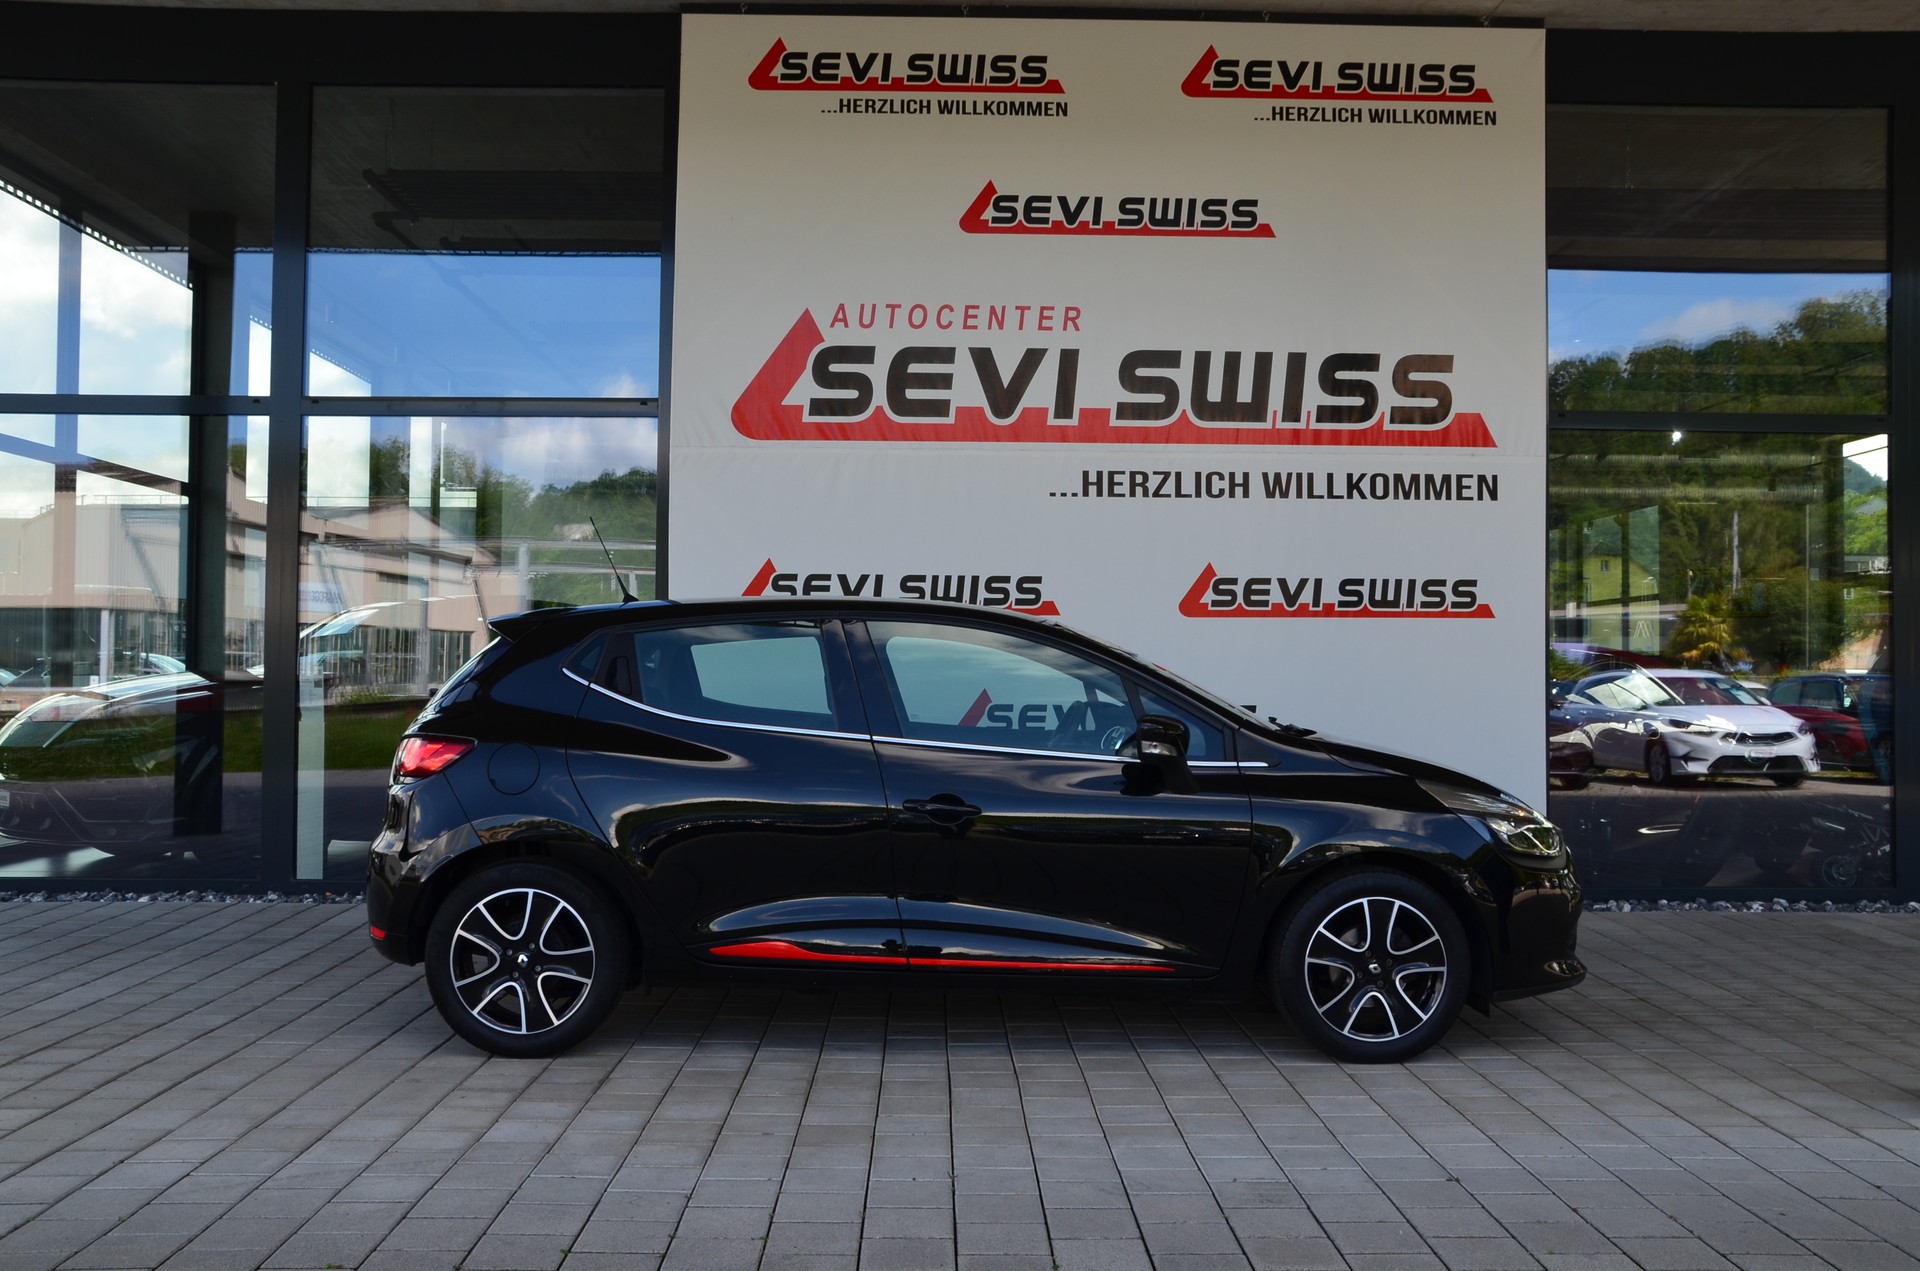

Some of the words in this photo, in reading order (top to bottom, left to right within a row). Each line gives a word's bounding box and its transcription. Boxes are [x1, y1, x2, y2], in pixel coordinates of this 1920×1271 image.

[778, 51, 894, 83] SEVI
[906, 53, 1048, 86] SWISS
[1212, 59, 1323, 91] SEVI
[1336, 61, 1476, 94] SWISS
[820, 98, 931, 115] ...HERZLICH
[937, 99, 1068, 117] WILLKOMMEN
[1254, 105, 1363, 123] ...HERZLICH
[1367, 108, 1497, 126] WILLKOMMEN
[990, 194, 1103, 226] SEVI
[1117, 196, 1259, 229] SWISS
[830, 303, 1083, 332] AUTOCENTER
[808, 345, 1080, 420] SEVI
[1115, 349, 1456, 425] SWISS
[1049, 470, 1250, 499] ...HERZLICH
[1261, 472, 1498, 502] WILLKOMMEN
[899, 574, 1043, 607] SWISS
[1210, 577, 1323, 609] SEVI
[1337, 578, 1478, 611] SWISS
